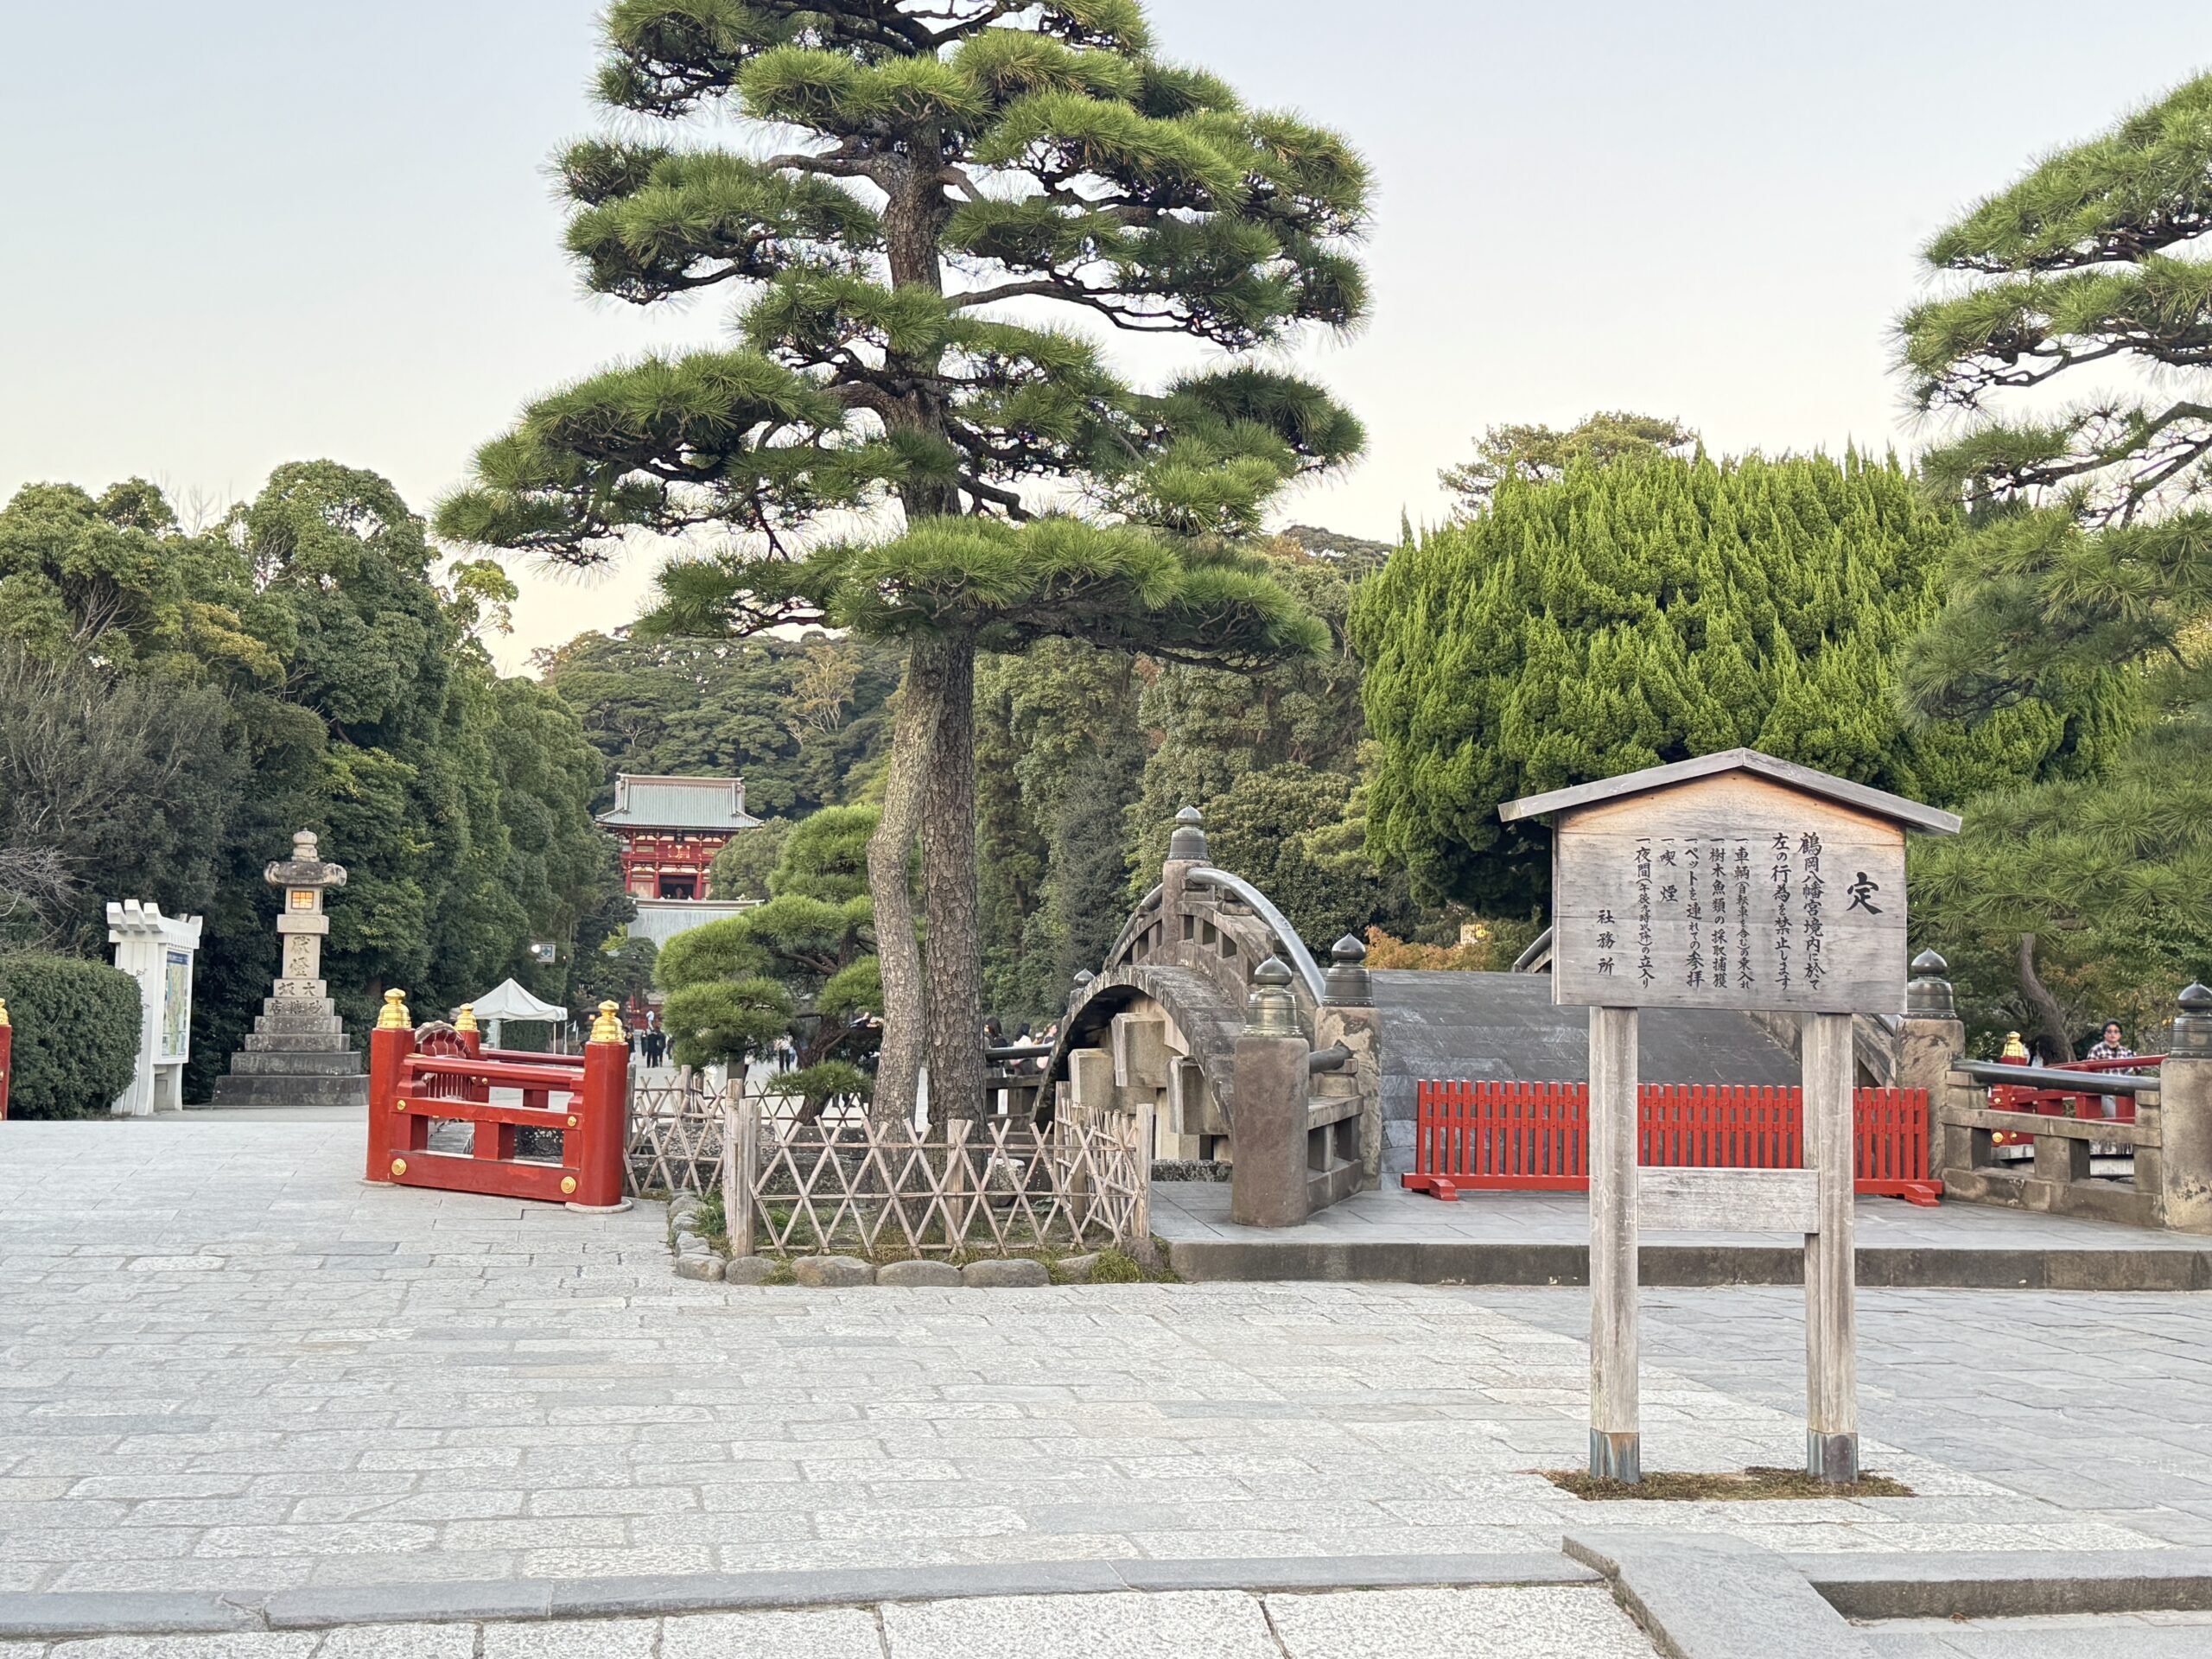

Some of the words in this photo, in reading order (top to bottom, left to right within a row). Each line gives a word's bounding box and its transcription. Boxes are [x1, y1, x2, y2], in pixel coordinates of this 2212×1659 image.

[1597, 910, 1616, 976] 社務所
[1770, 832, 1792, 991] 左の行為を禁止します
[1797, 831, 1826, 990] 鶴岡八幡宮境内に於て
[1846, 872, 1884, 915] 定
